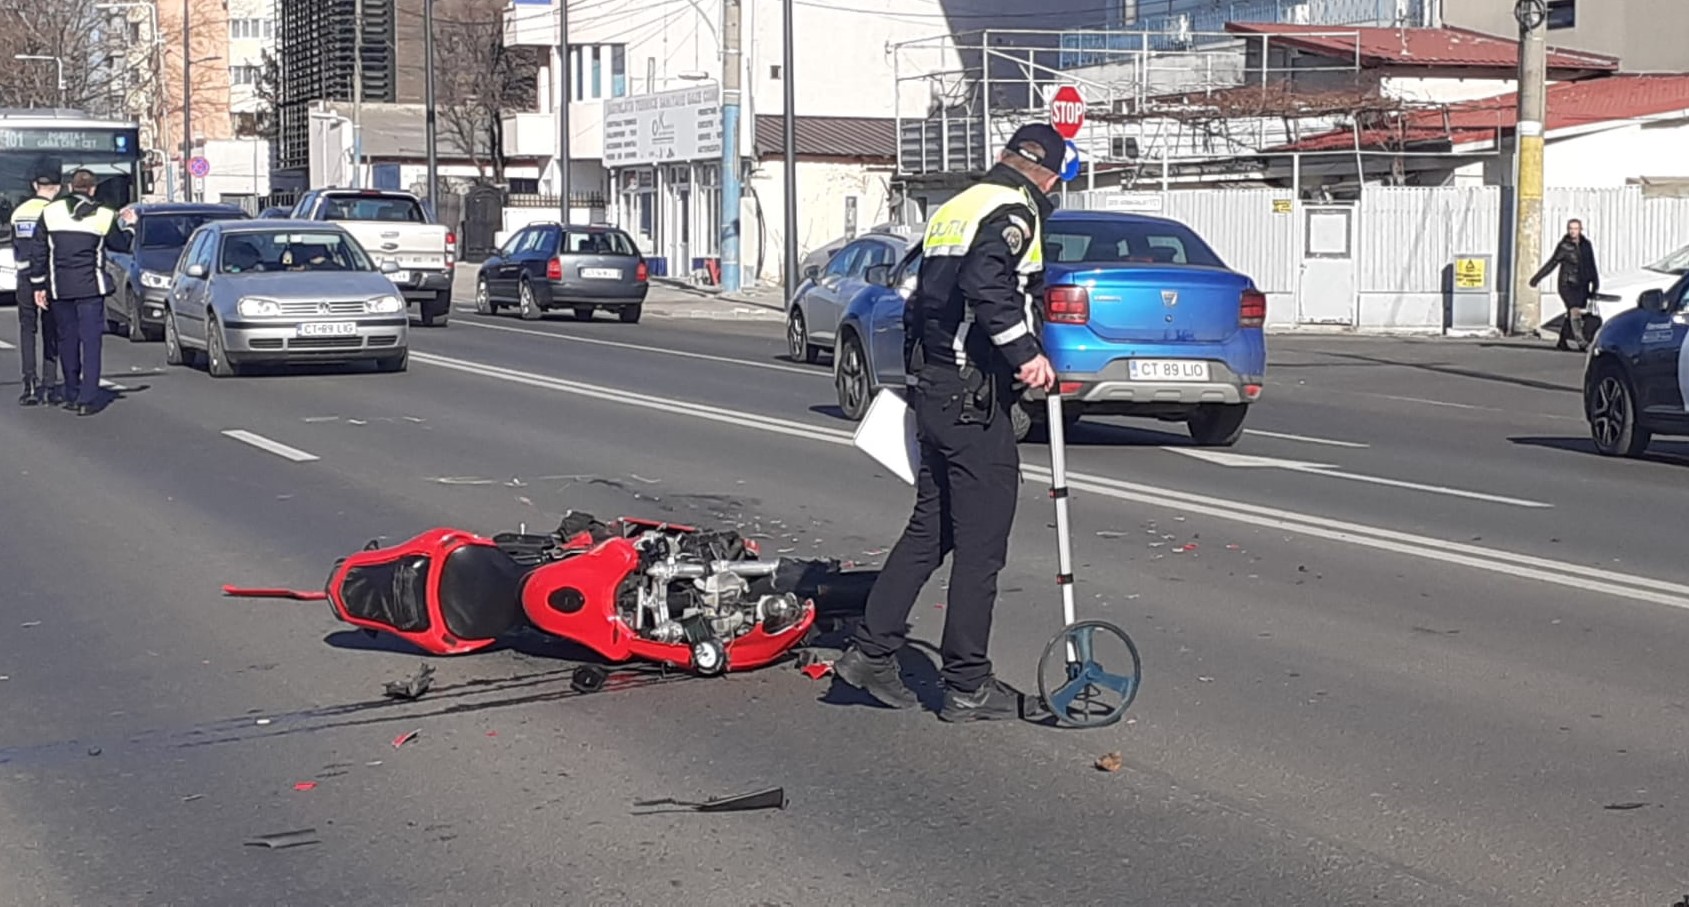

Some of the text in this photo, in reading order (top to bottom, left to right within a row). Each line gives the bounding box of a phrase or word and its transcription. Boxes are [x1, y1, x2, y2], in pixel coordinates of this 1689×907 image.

[1053, 101, 1082, 124] STOP
[1141, 362, 1203, 377] CT 89 LIO
